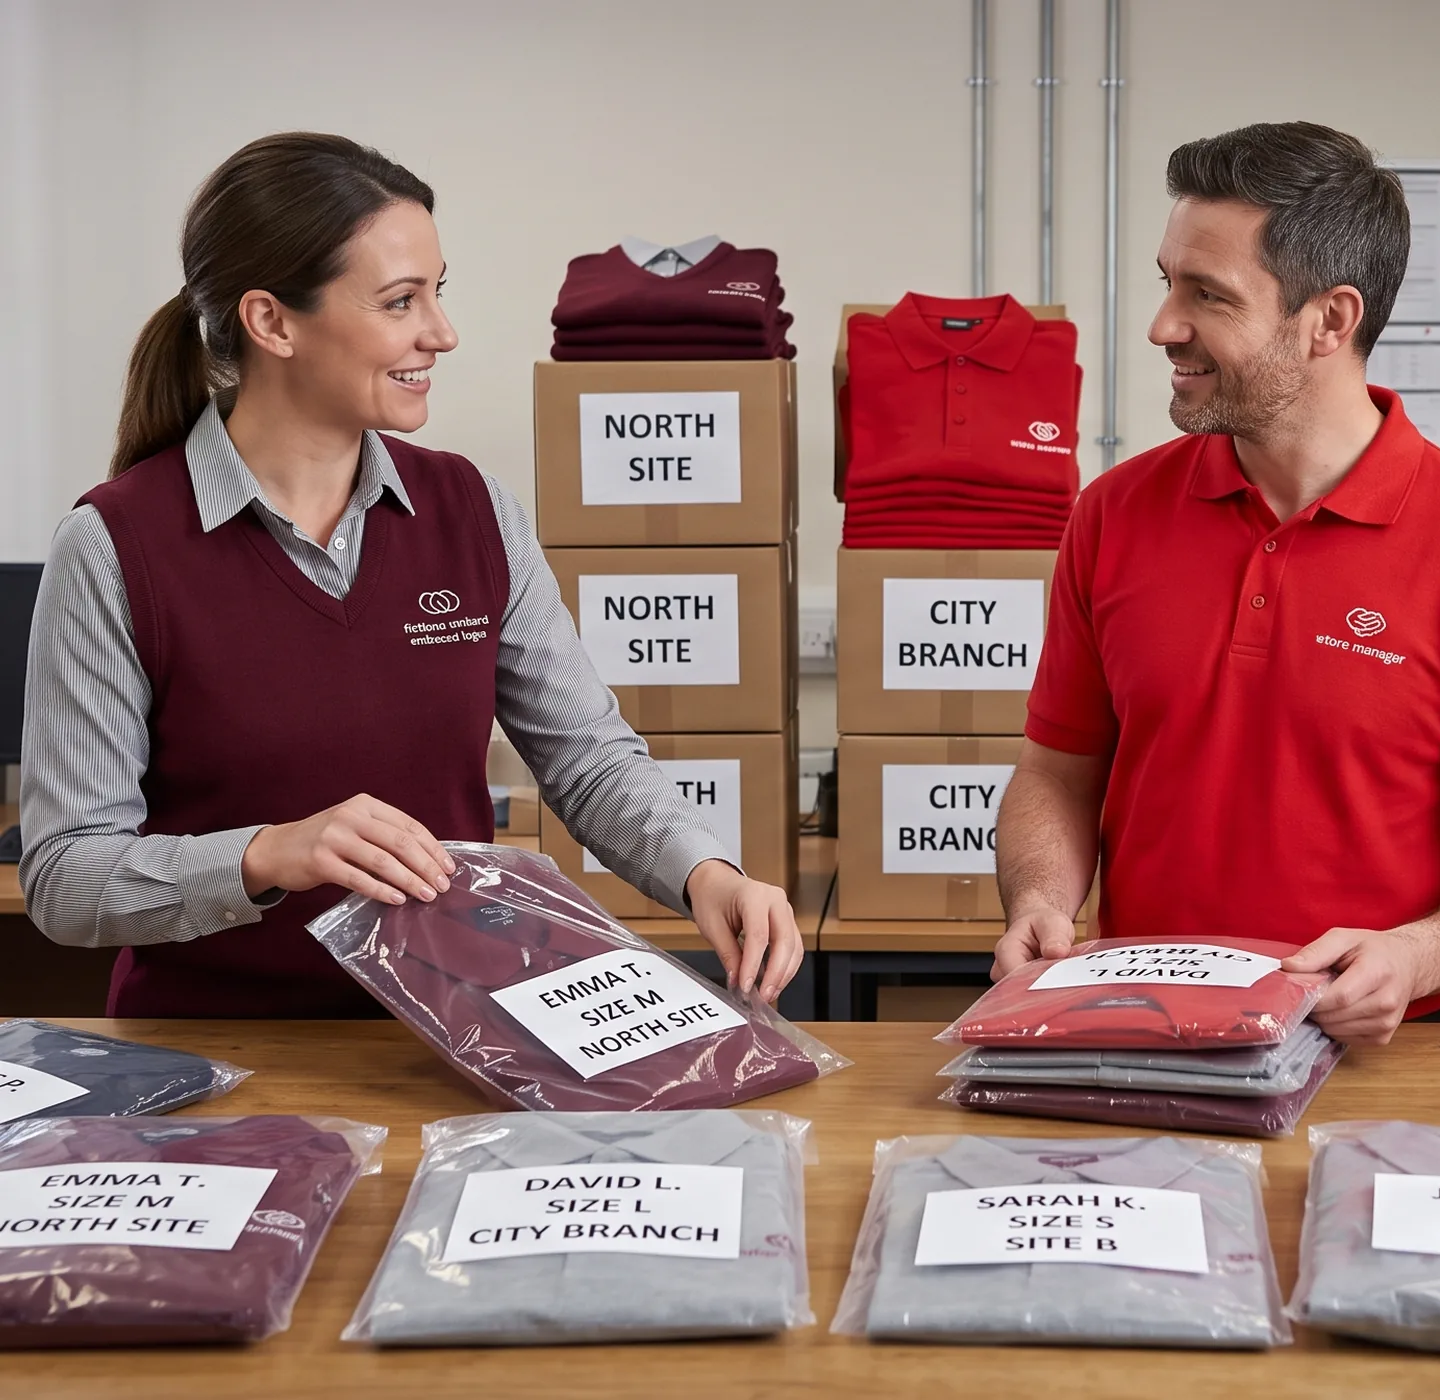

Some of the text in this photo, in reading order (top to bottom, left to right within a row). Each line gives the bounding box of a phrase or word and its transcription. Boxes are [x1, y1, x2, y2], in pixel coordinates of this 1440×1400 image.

[605, 413, 715, 439] NORTH
[629, 456, 693, 482] SITE
[604, 595, 714, 621] NORTH
[930, 600, 997, 625] CITY
[628, 638, 692, 664] SITE
[899, 642, 1027, 668] BRANCH
[1351, 643, 1407, 665] manager
[929, 784, 996, 809] CITY
[899, 826, 996, 851] BRANC
[1125, 957, 1204, 967] SIZE L
[1089, 968, 1210, 979] DAVID L.
[538, 963, 652, 1009] EMMA T.
[580, 989, 665, 1028] SIZE M
[578, 1002, 720, 1060] NORTH SITE
[40, 1173, 206, 1188] EMMA T.
[524, 1175, 681, 1192] DAVID L.
[48, 1194, 175, 1209] SIZE M
[545, 1198, 652, 1214] SIZE L
[977, 1194, 1146, 1211] SARAH K.
[126, 1217, 209, 1235] SITE
[1008, 1215, 1115, 1229] SIZE S
[468, 1223, 719, 1245] CITY BRANCH
[1006, 1236, 1118, 1252] SITE B
